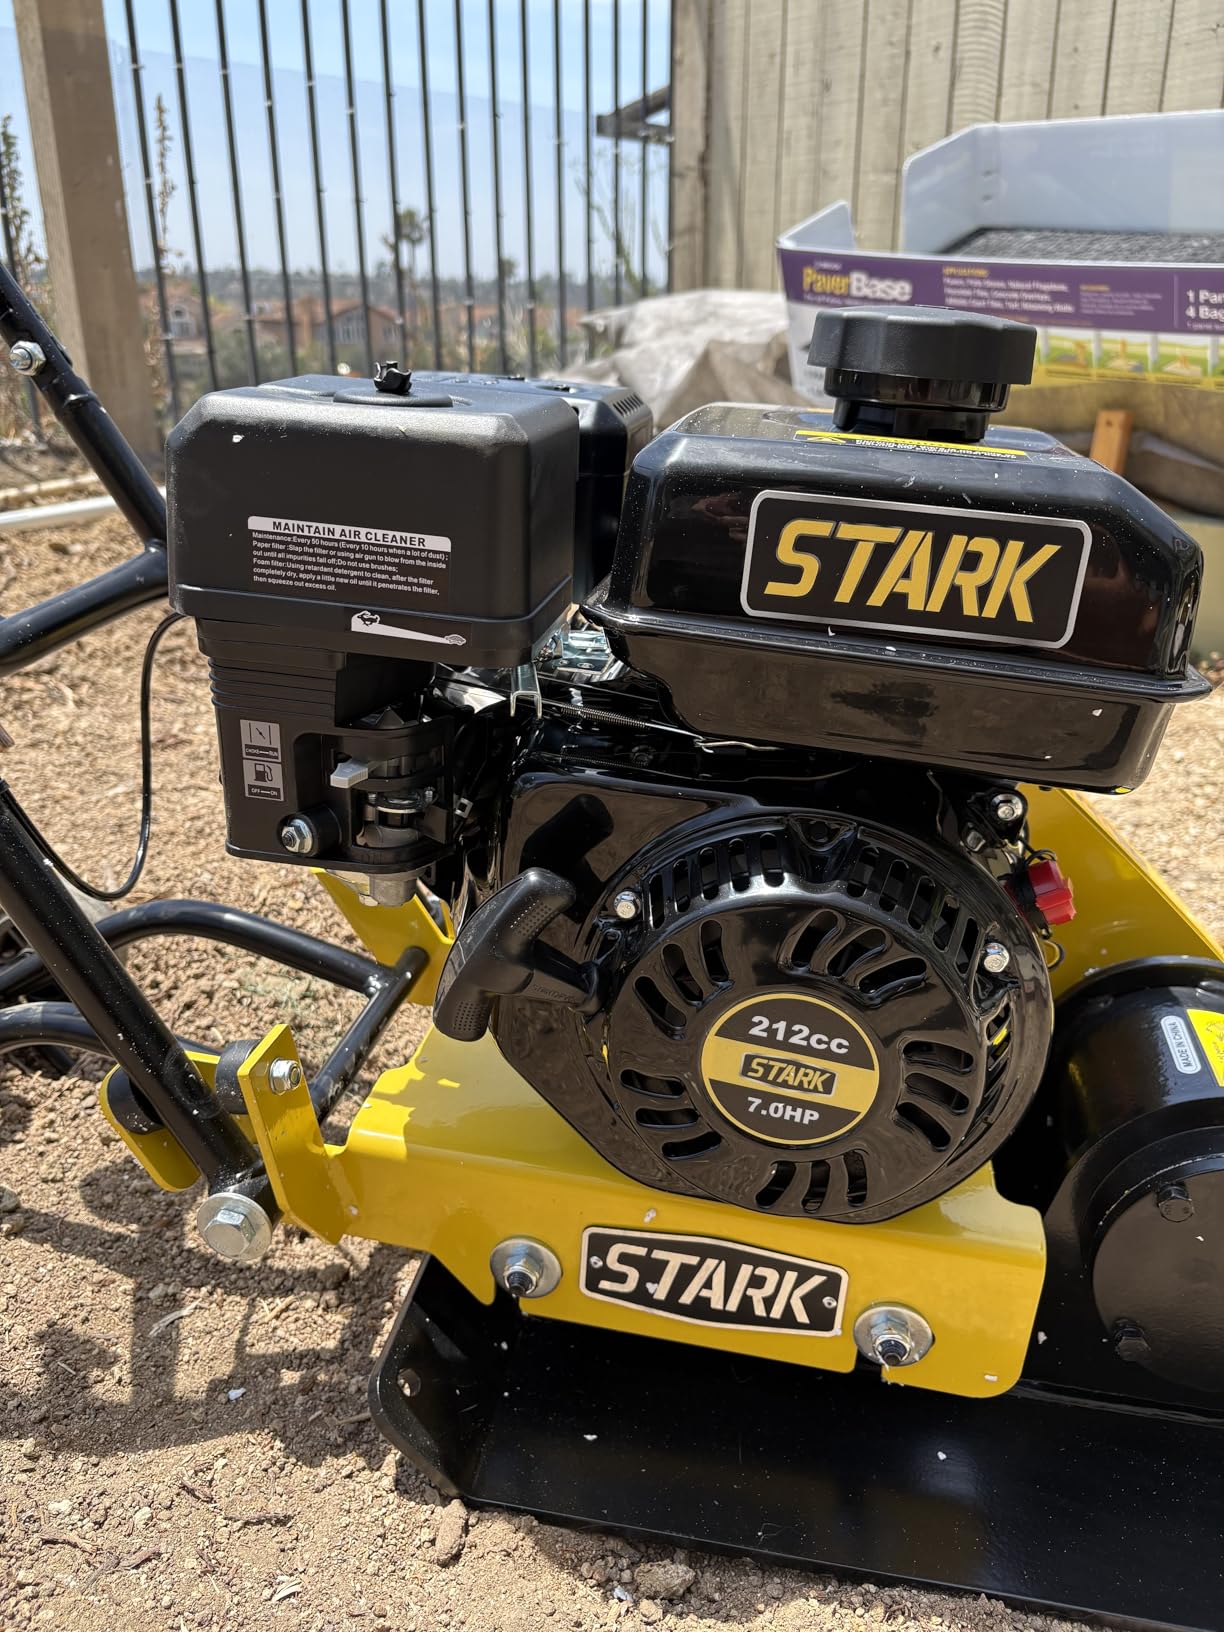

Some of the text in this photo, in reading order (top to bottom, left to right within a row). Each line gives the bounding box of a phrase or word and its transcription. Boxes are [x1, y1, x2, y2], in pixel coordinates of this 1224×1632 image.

[1186, 290, 1195, 303] 1
[1185, 306, 1196, 319] 4
[273, 522, 426, 547] MAINTAIN AIR CLEANER
[320, 539, 338, 547] hours
[339, 542, 360, 550] (Every
[253, 541, 270, 549] Paper
[337, 551, 354, 559] using
[400, 557, 415, 565] from
[427, 560, 446, 568] inside
[286, 553, 316, 562] impurities
[253, 567, 286, 577] completely
[299, 572, 316, 580] apply
[378, 582, 411, 591] penetrates
[305, 565, 333, 573] retardant
[334, 568, 364, 577] detergent
[419, 577, 434, 585] filter
[764, 519, 1062, 623] STARK
[748, 1016, 850, 1054] 212cc
[1168, 1022, 1182, 1040] CHINA
[1178, 1048, 1193, 1067] MADE
[747, 1058, 832, 1092] STARK
[747, 1097, 820, 1124] 7.0HP
[598, 1243, 827, 1324] STARK
